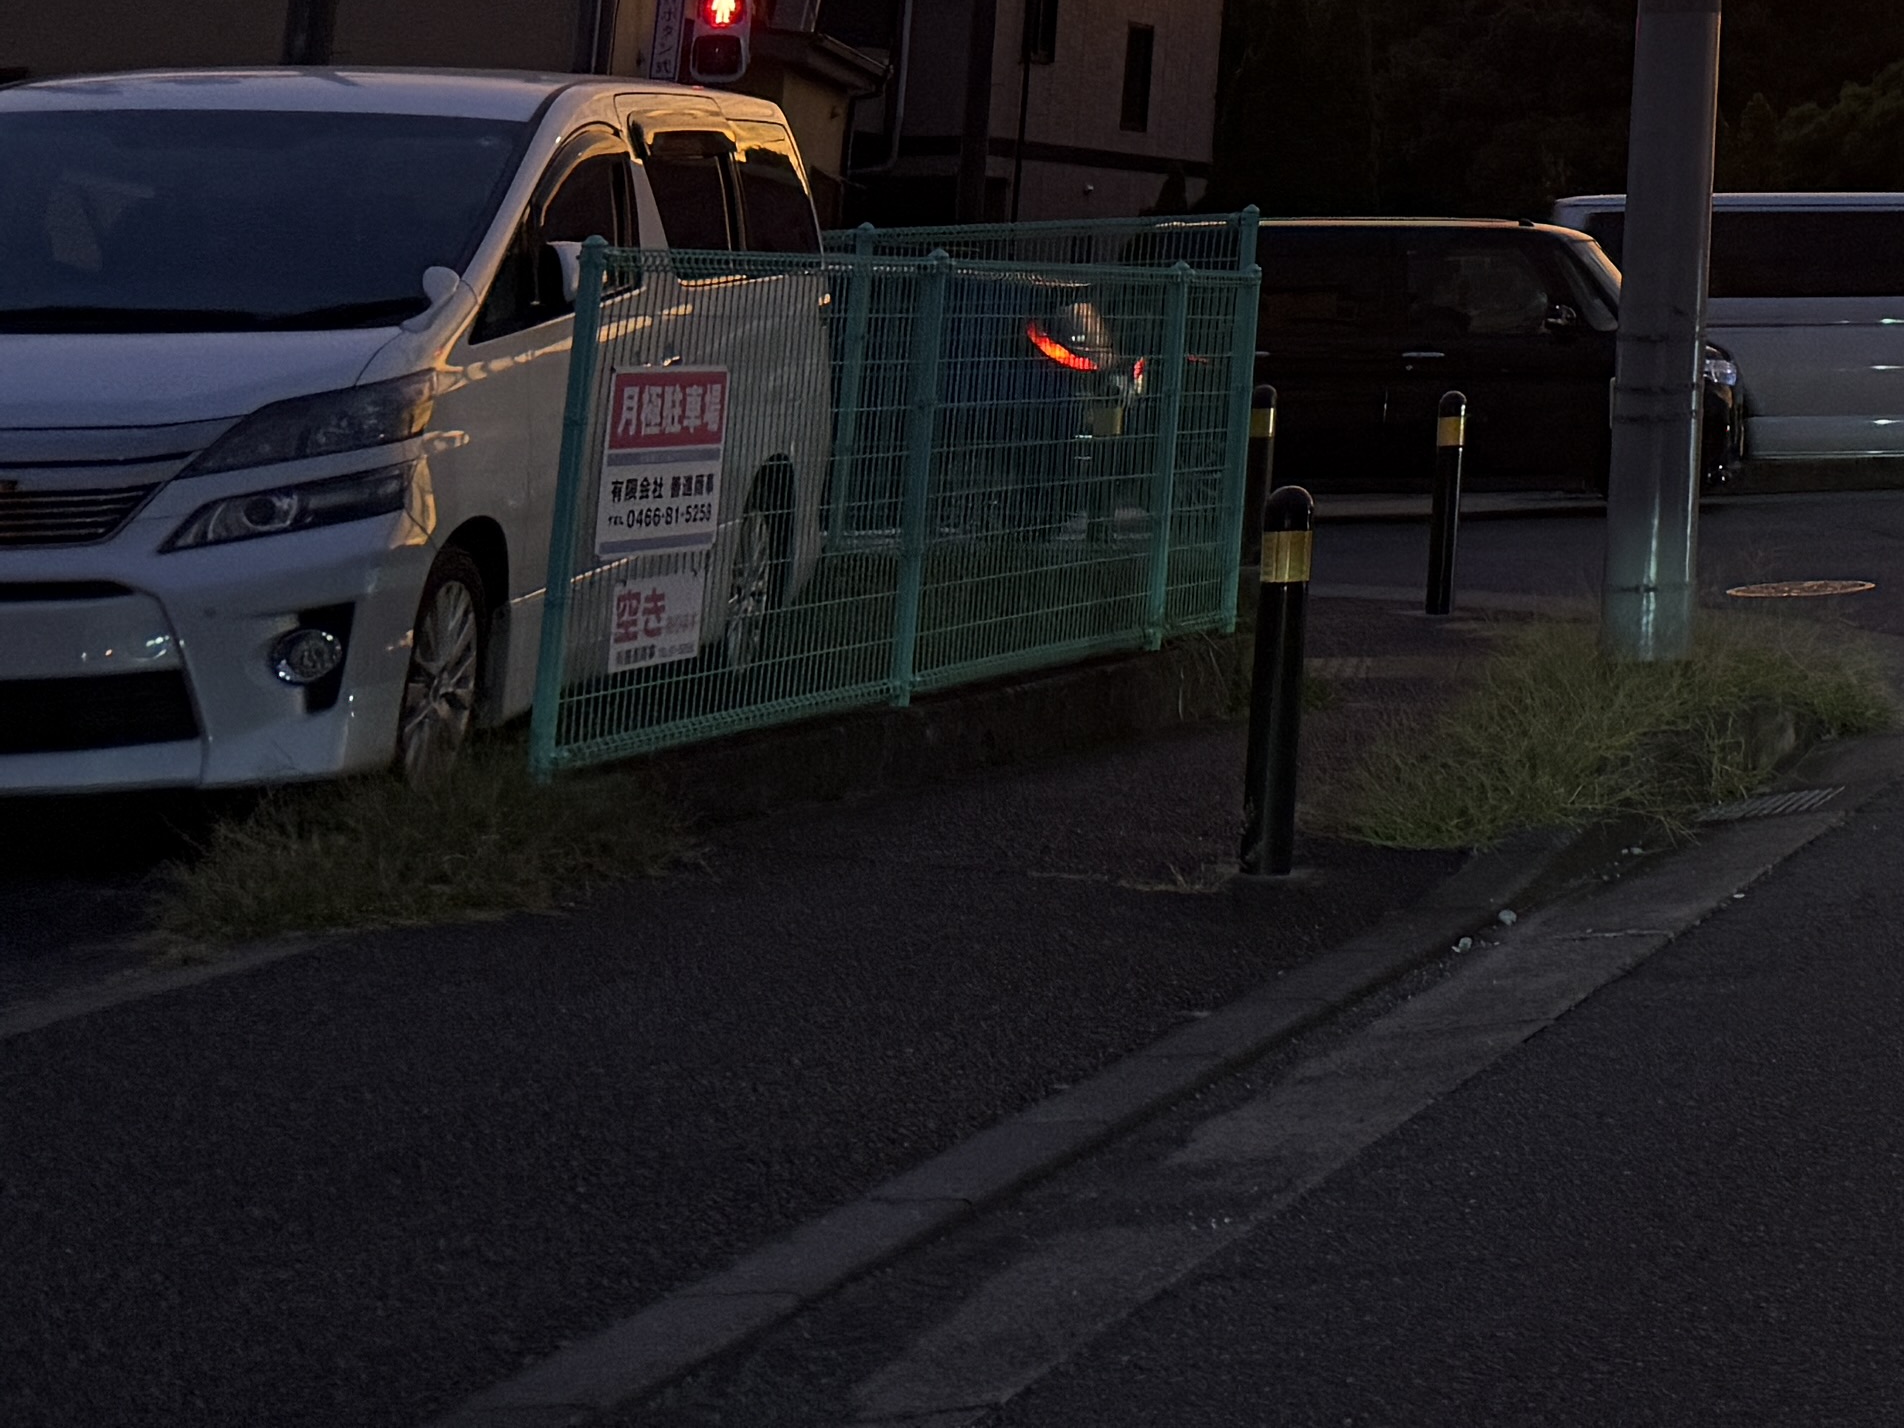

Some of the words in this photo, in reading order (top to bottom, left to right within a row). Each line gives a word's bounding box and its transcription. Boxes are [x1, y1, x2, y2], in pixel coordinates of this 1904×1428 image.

[617, 383, 723, 437] 月極駐車場
[612, 476, 664, 504] 有限会社
